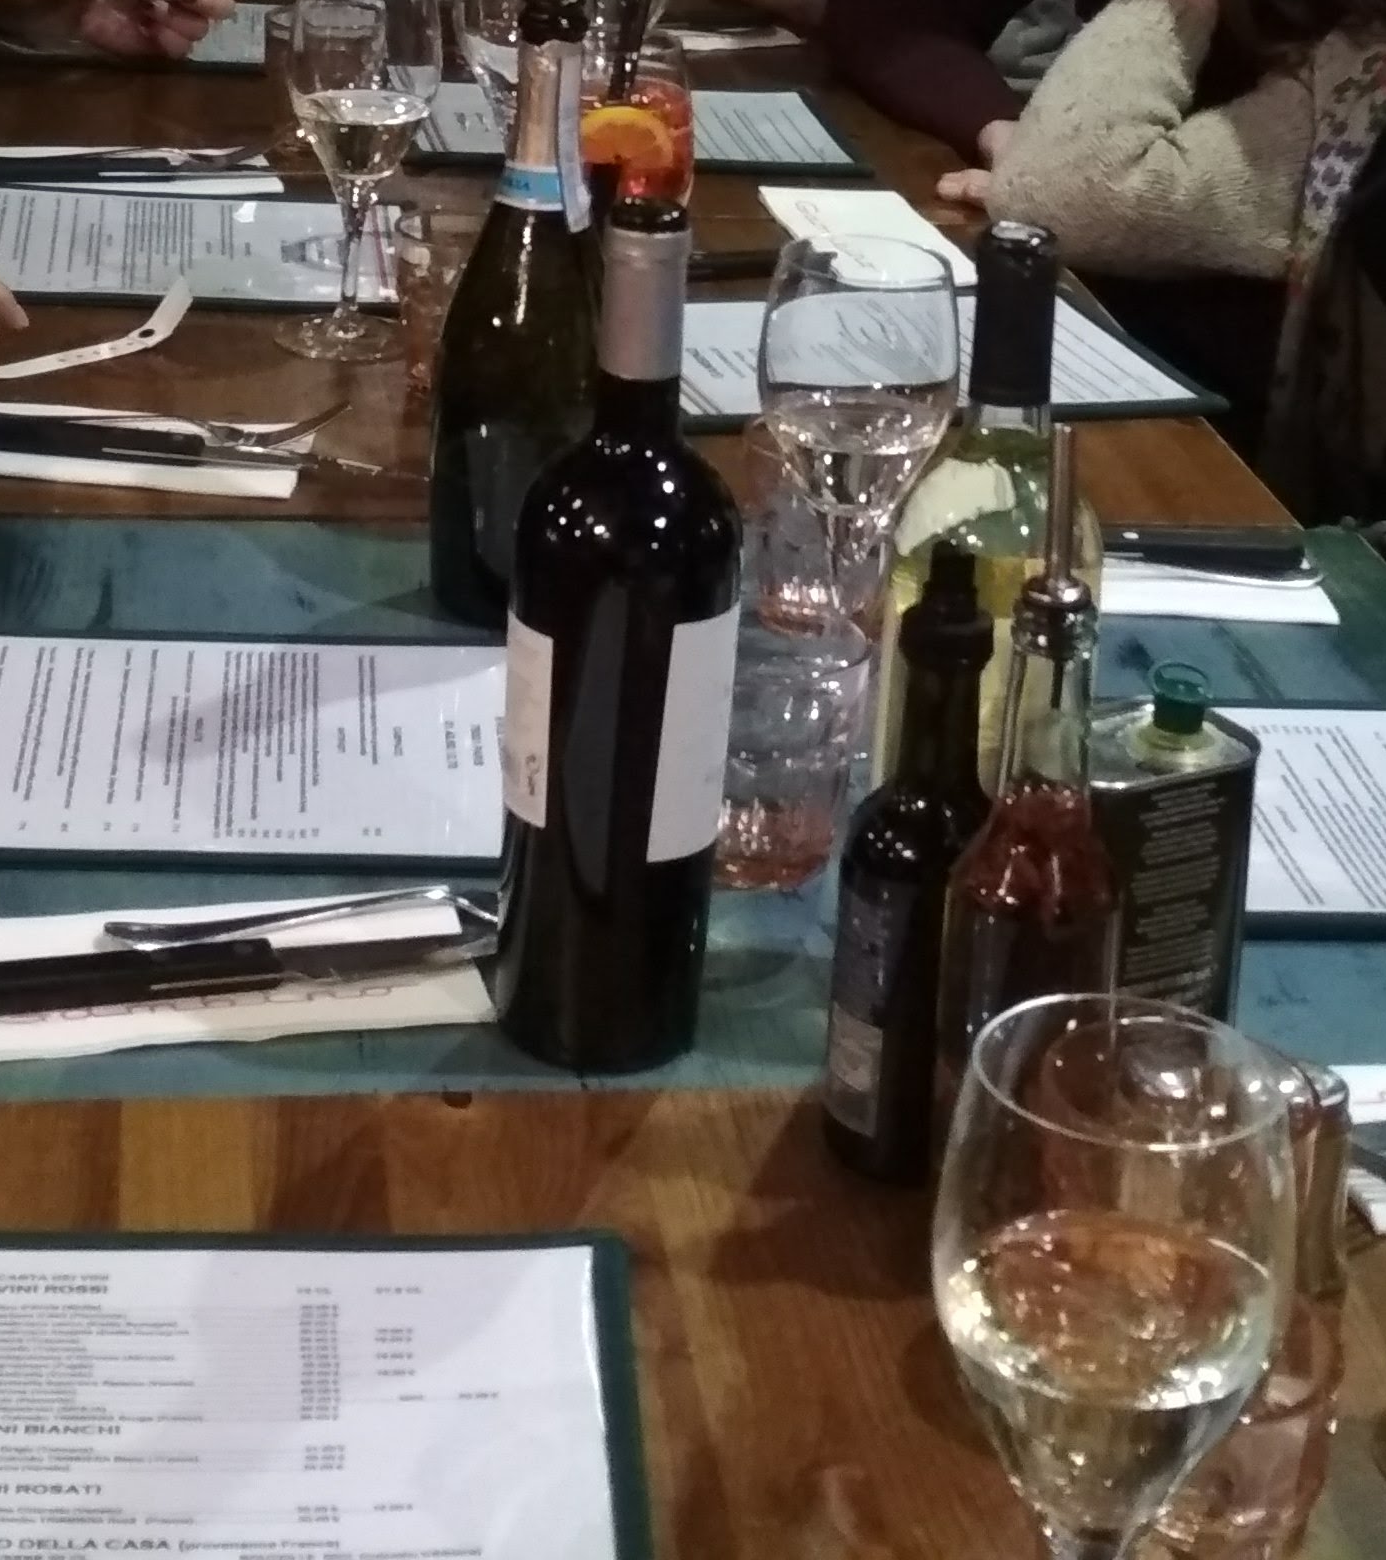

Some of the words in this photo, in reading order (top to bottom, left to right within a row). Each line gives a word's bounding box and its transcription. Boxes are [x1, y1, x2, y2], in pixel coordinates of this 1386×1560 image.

[43, 1284, 109, 1294] ROSSI
[23, 1424, 121, 1435] BIANCHI
[14, 1483, 103, 1495] ROSATI
[18, 1537, 99, 1550] DELLA
[104, 1537, 171, 1550] CASA
